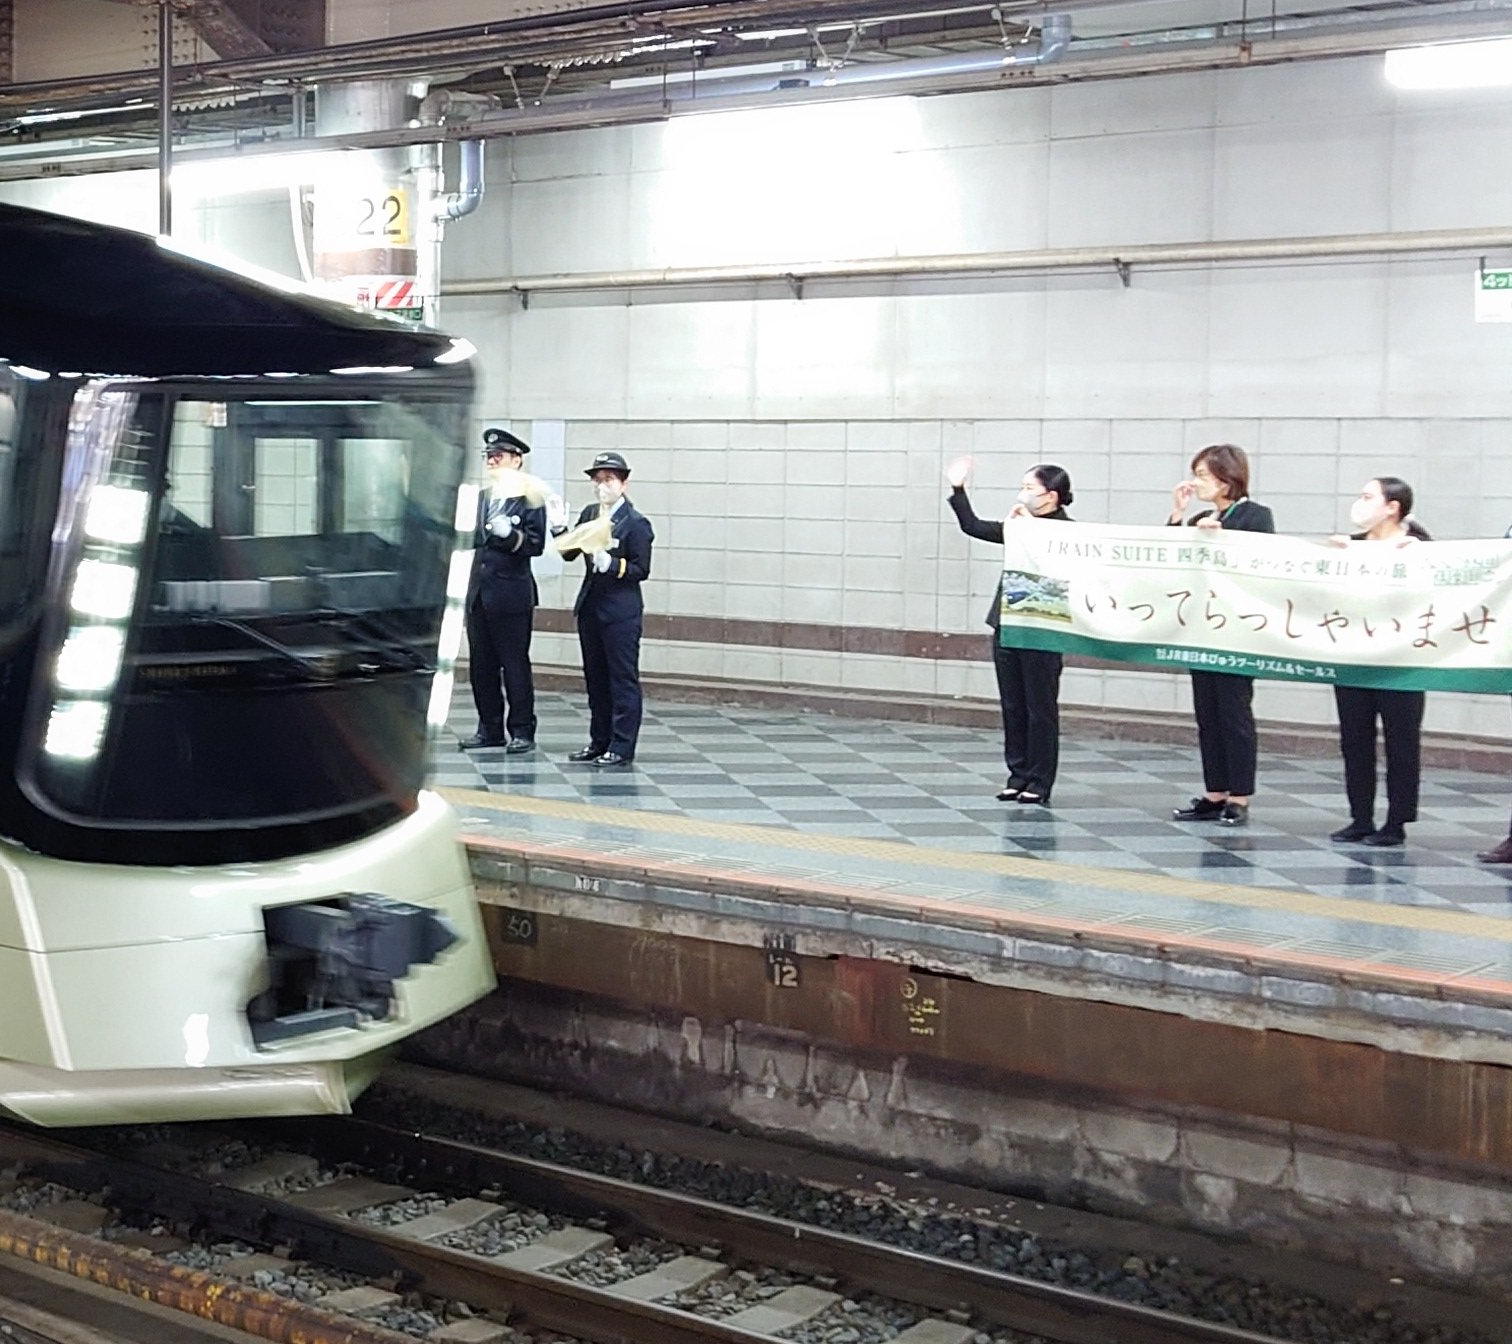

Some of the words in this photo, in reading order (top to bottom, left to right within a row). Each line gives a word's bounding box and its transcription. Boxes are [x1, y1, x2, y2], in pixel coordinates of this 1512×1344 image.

[357, 195, 401, 235] 22
[1111, 545, 1168, 563] SUITE
[1084, 589, 1497, 649] いってらっしゃいませ
[774, 963, 798, 986] 12
